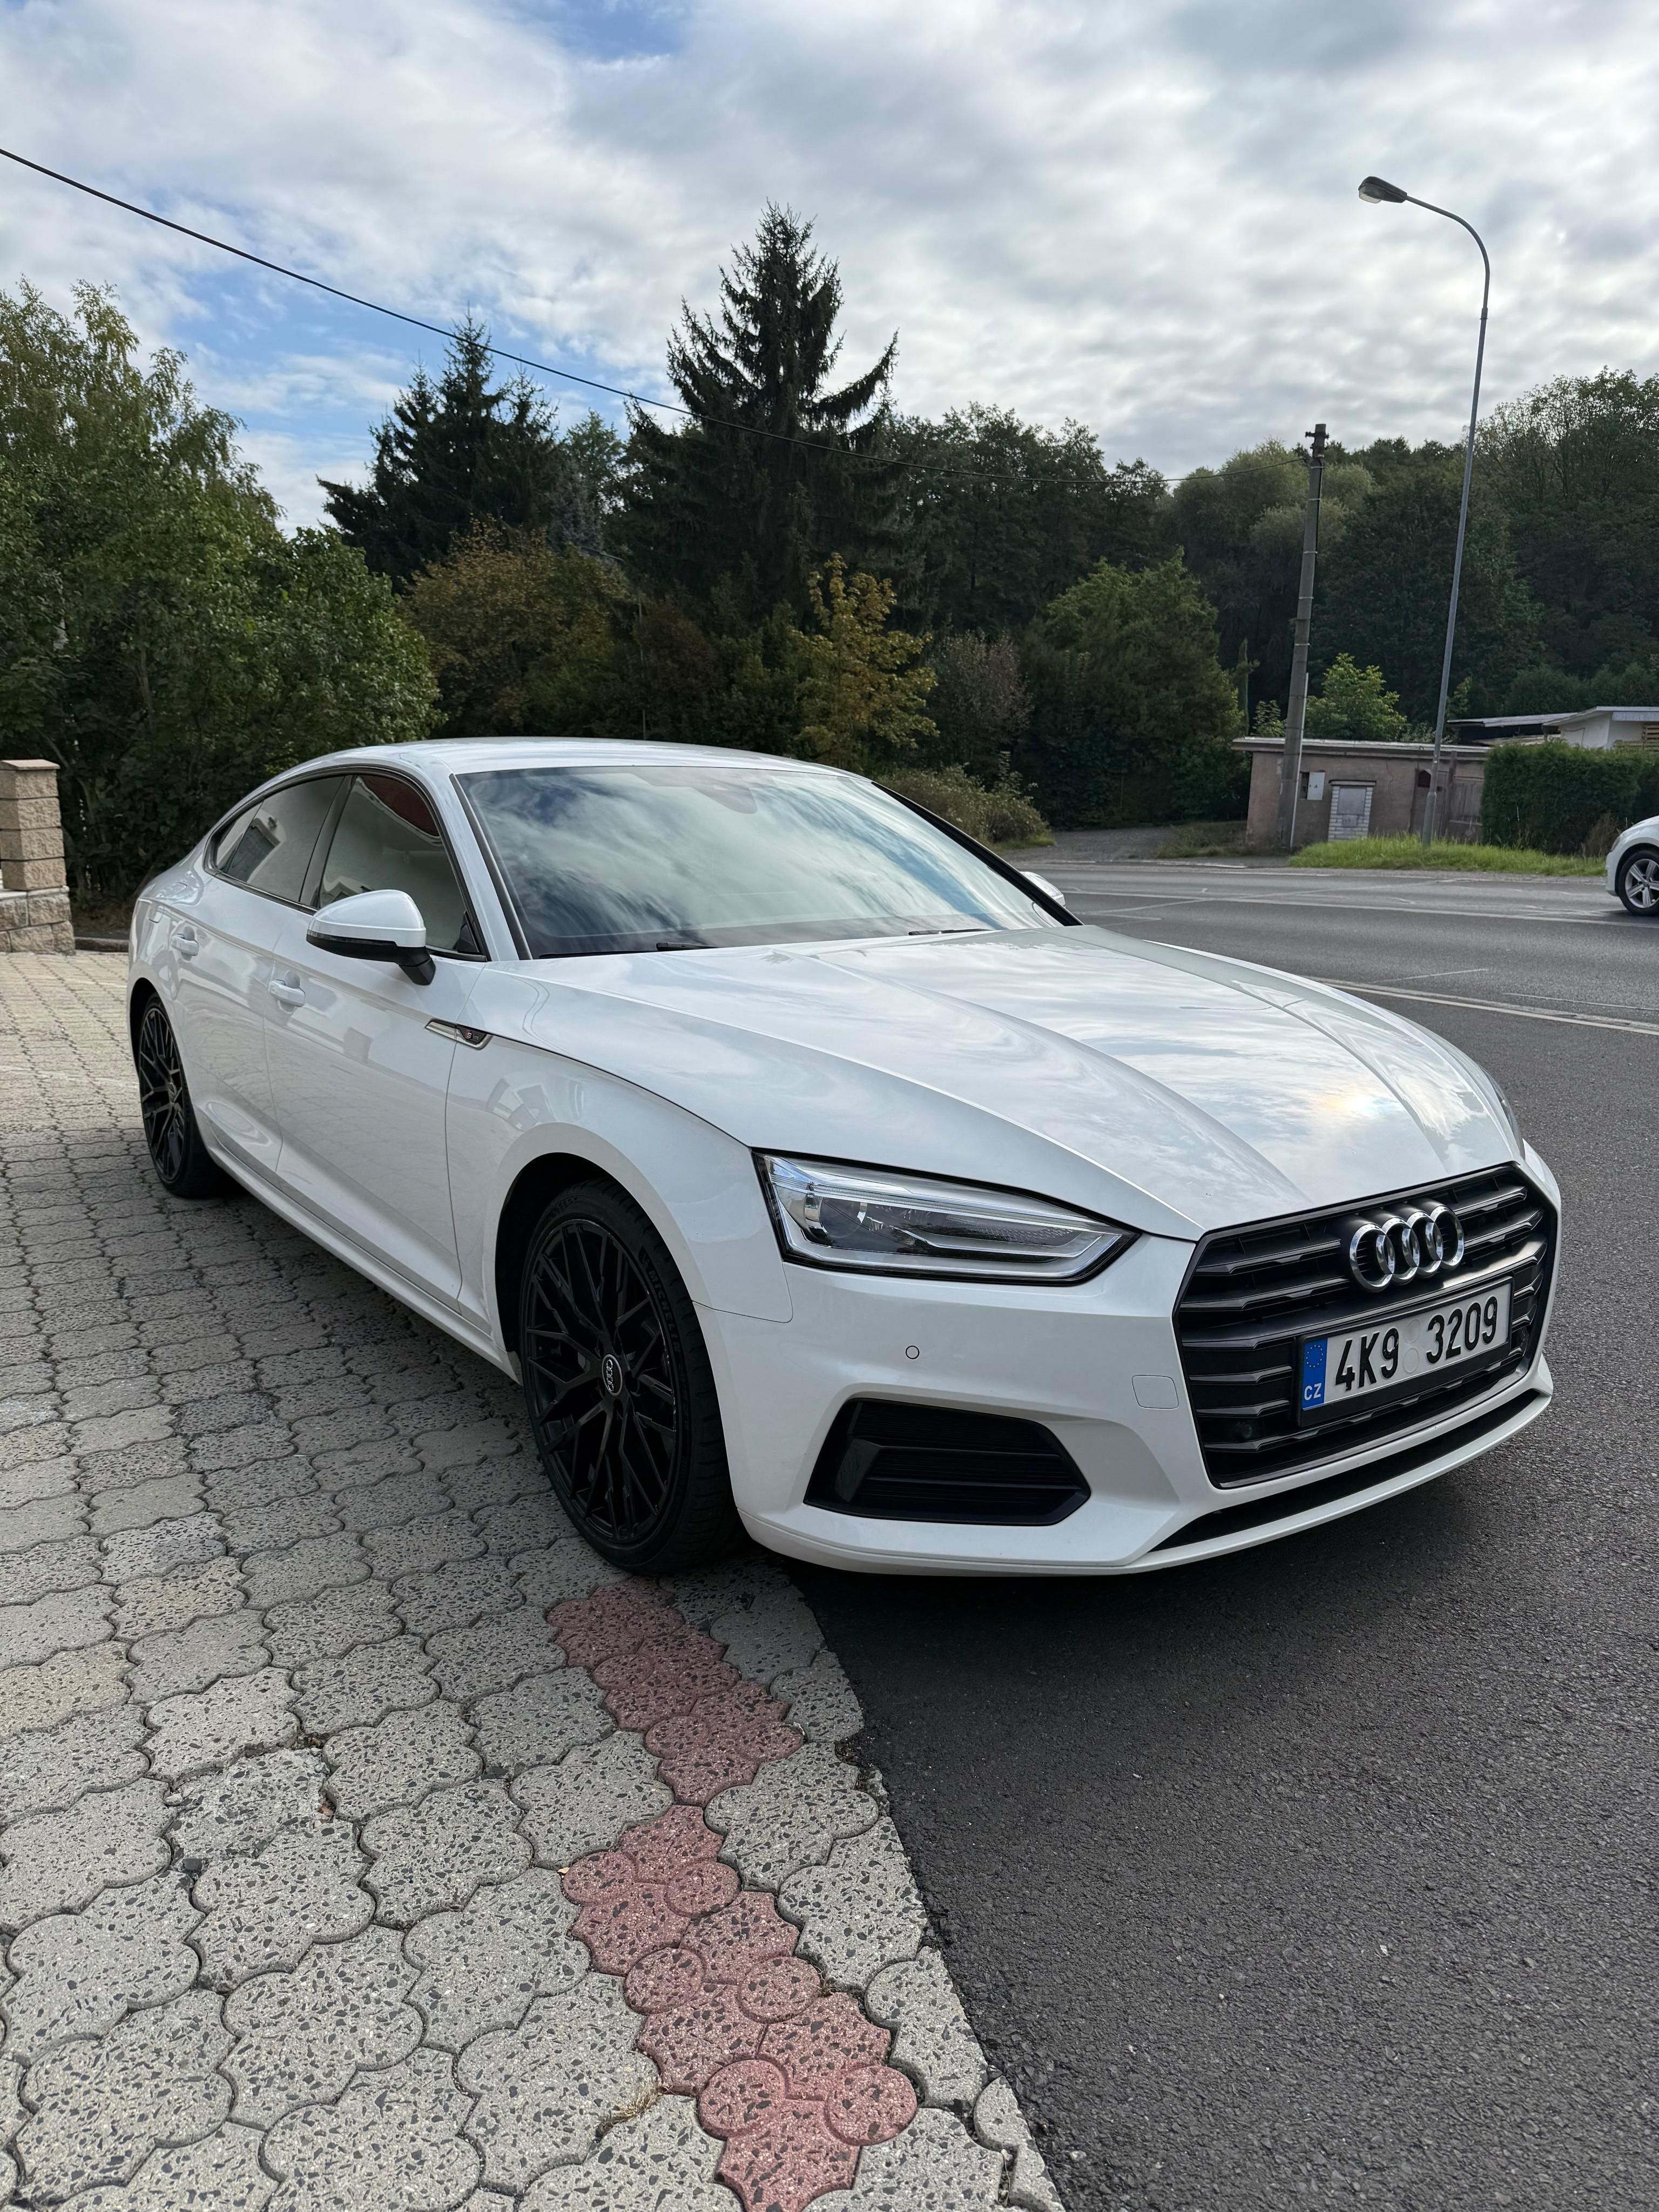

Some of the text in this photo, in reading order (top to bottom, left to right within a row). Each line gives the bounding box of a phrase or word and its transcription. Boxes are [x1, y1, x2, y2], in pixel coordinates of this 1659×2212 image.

[648, 1270, 681, 1353] MICHELIN
[1335, 1296, 1498, 1391] 4K9 3209
[1304, 1382, 1321, 1401] CZ
